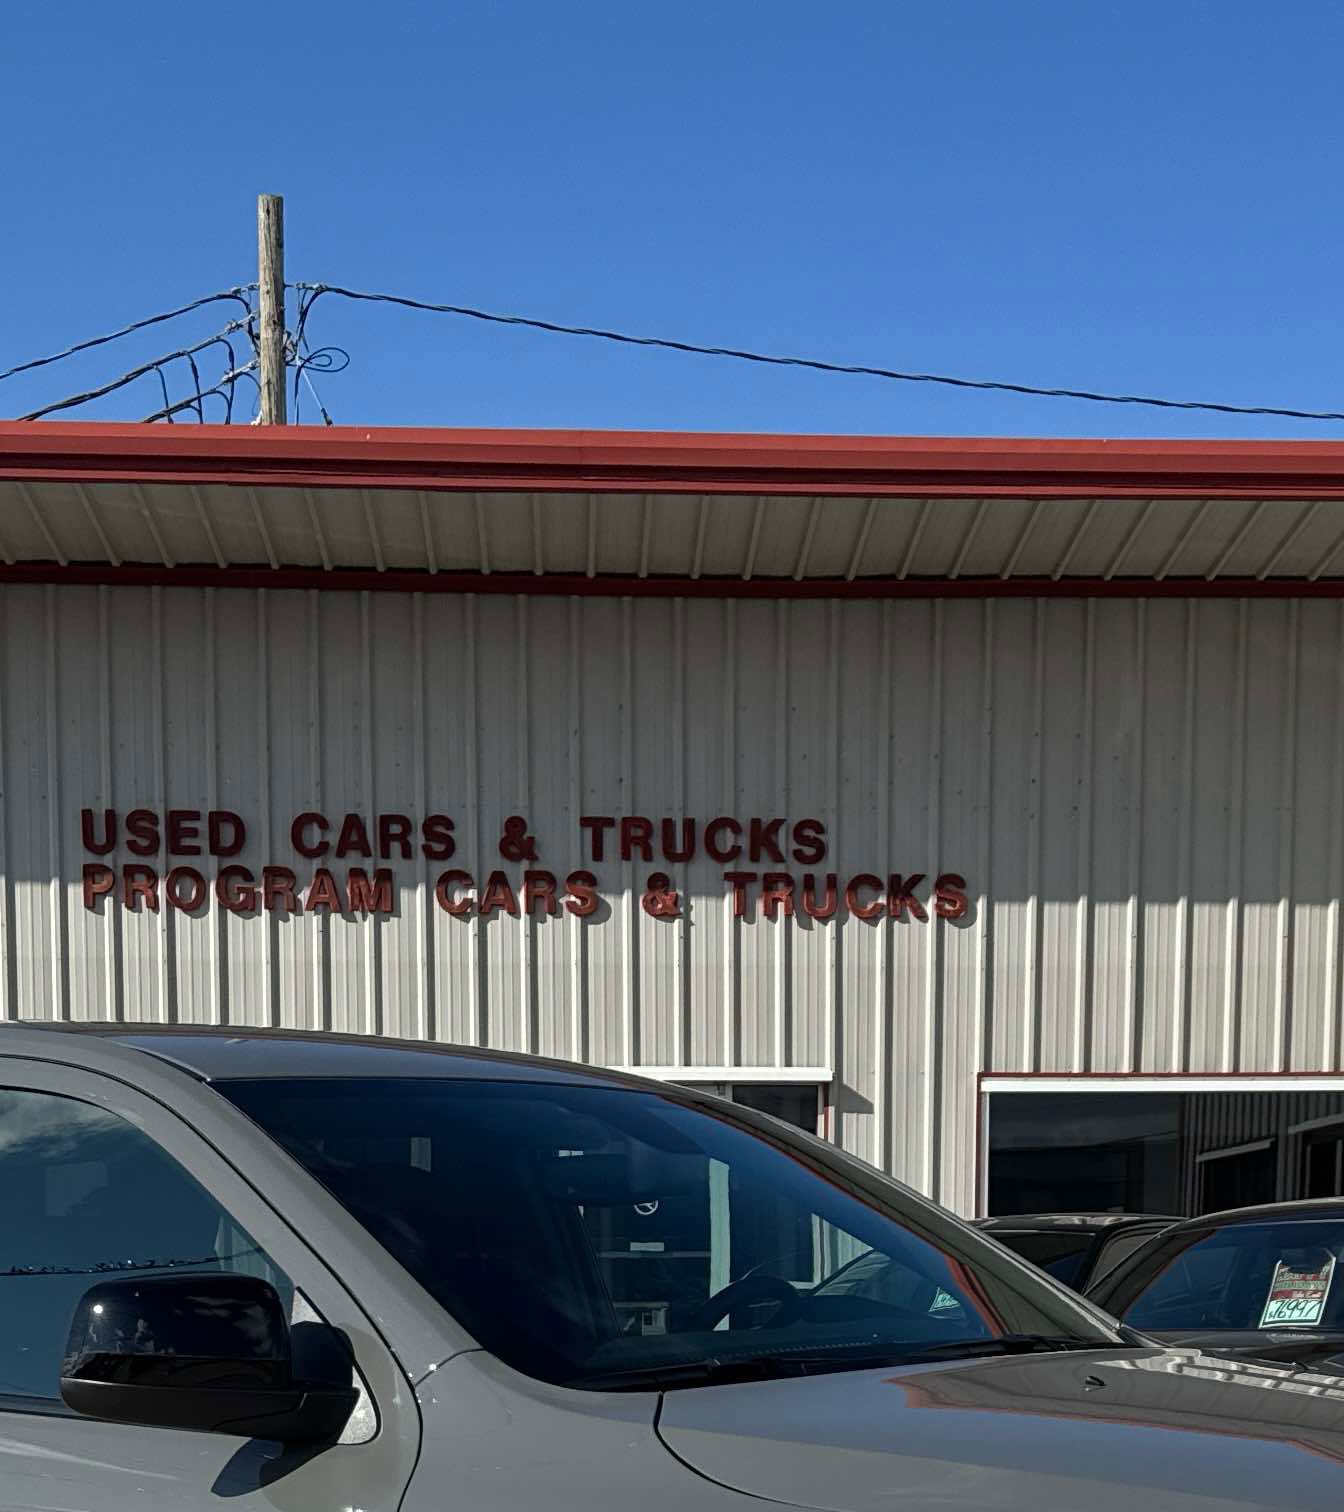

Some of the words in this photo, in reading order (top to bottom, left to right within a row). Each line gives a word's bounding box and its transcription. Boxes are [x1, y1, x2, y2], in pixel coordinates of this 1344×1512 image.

[80, 808, 247, 856] USED
[290, 811, 456, 861] CARS
[498, 815, 539, 863] &
[579, 815, 827, 865] TRUCKS
[82, 863, 394, 914] PROGRAM
[435, 869, 600, 917] CARS
[641, 871, 682, 919] &
[723, 871, 969, 921] TRUCKS
